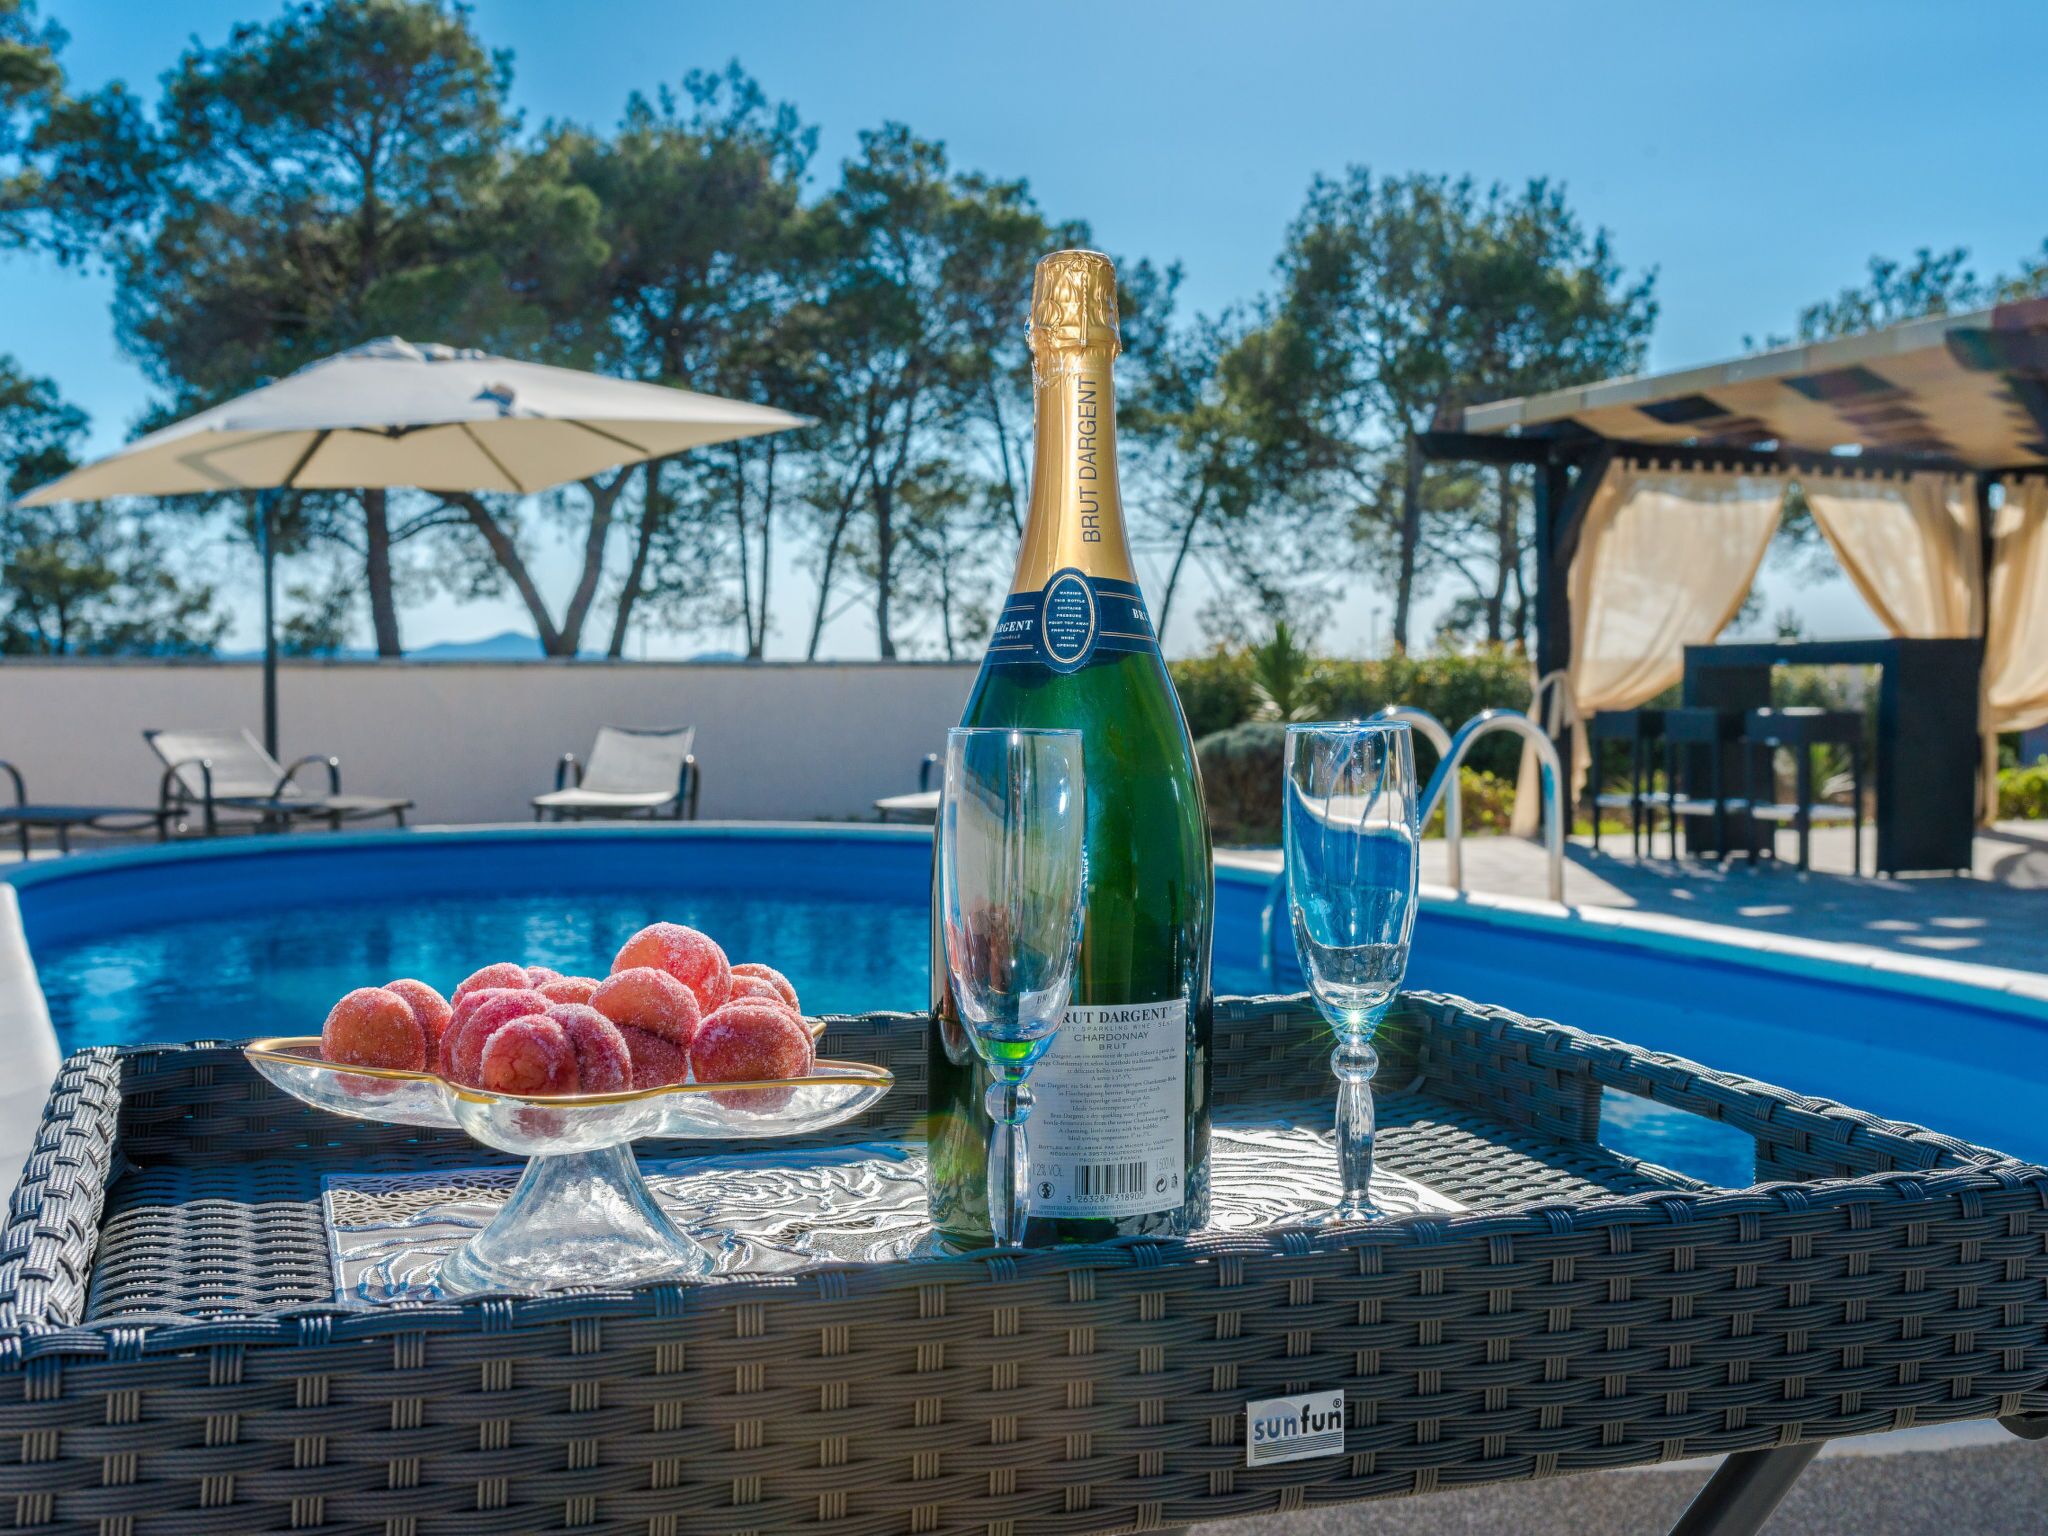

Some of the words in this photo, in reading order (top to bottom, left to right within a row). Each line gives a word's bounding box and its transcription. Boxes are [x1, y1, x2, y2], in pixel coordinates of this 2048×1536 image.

[1077, 376, 1097, 480] DARGENT
[1079, 486, 1100, 543] BRUT
[1062, 1011, 1094, 1024] RUT
[1099, 1007, 1169, 1023] DARGENT
[1073, 1031, 1149, 1042] CHARDONNAY
[1098, 1042, 1128, 1051] BRUT
[1066, 1195, 1072, 1203] 3
[1077, 1194, 1110, 1203] 263287
[1114, 1191, 1144, 1201] 318900
